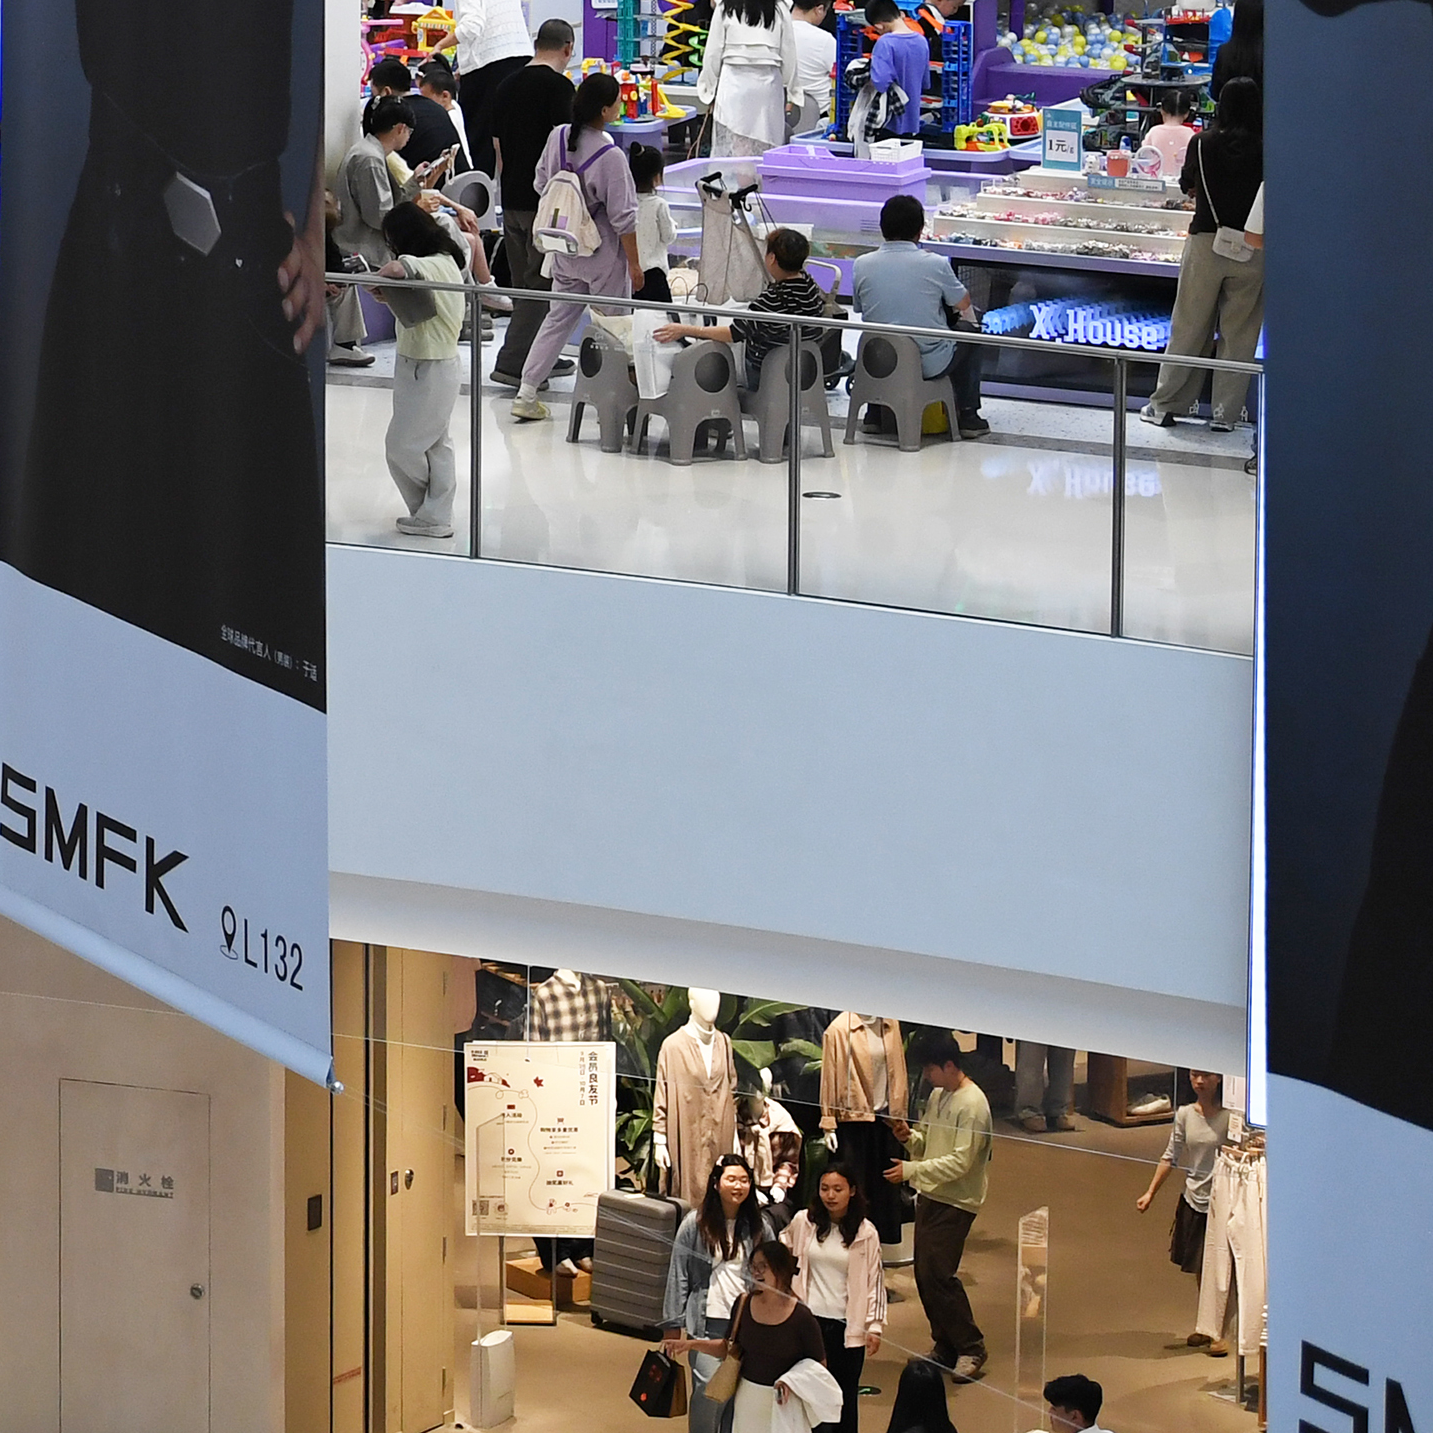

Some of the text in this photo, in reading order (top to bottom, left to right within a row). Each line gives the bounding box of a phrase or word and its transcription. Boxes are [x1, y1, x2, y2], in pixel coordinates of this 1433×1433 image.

[0, 761, 189, 934] SMFK
[244, 918, 304, 991] L132
[588, 1051, 598, 1105] 会员良友节
